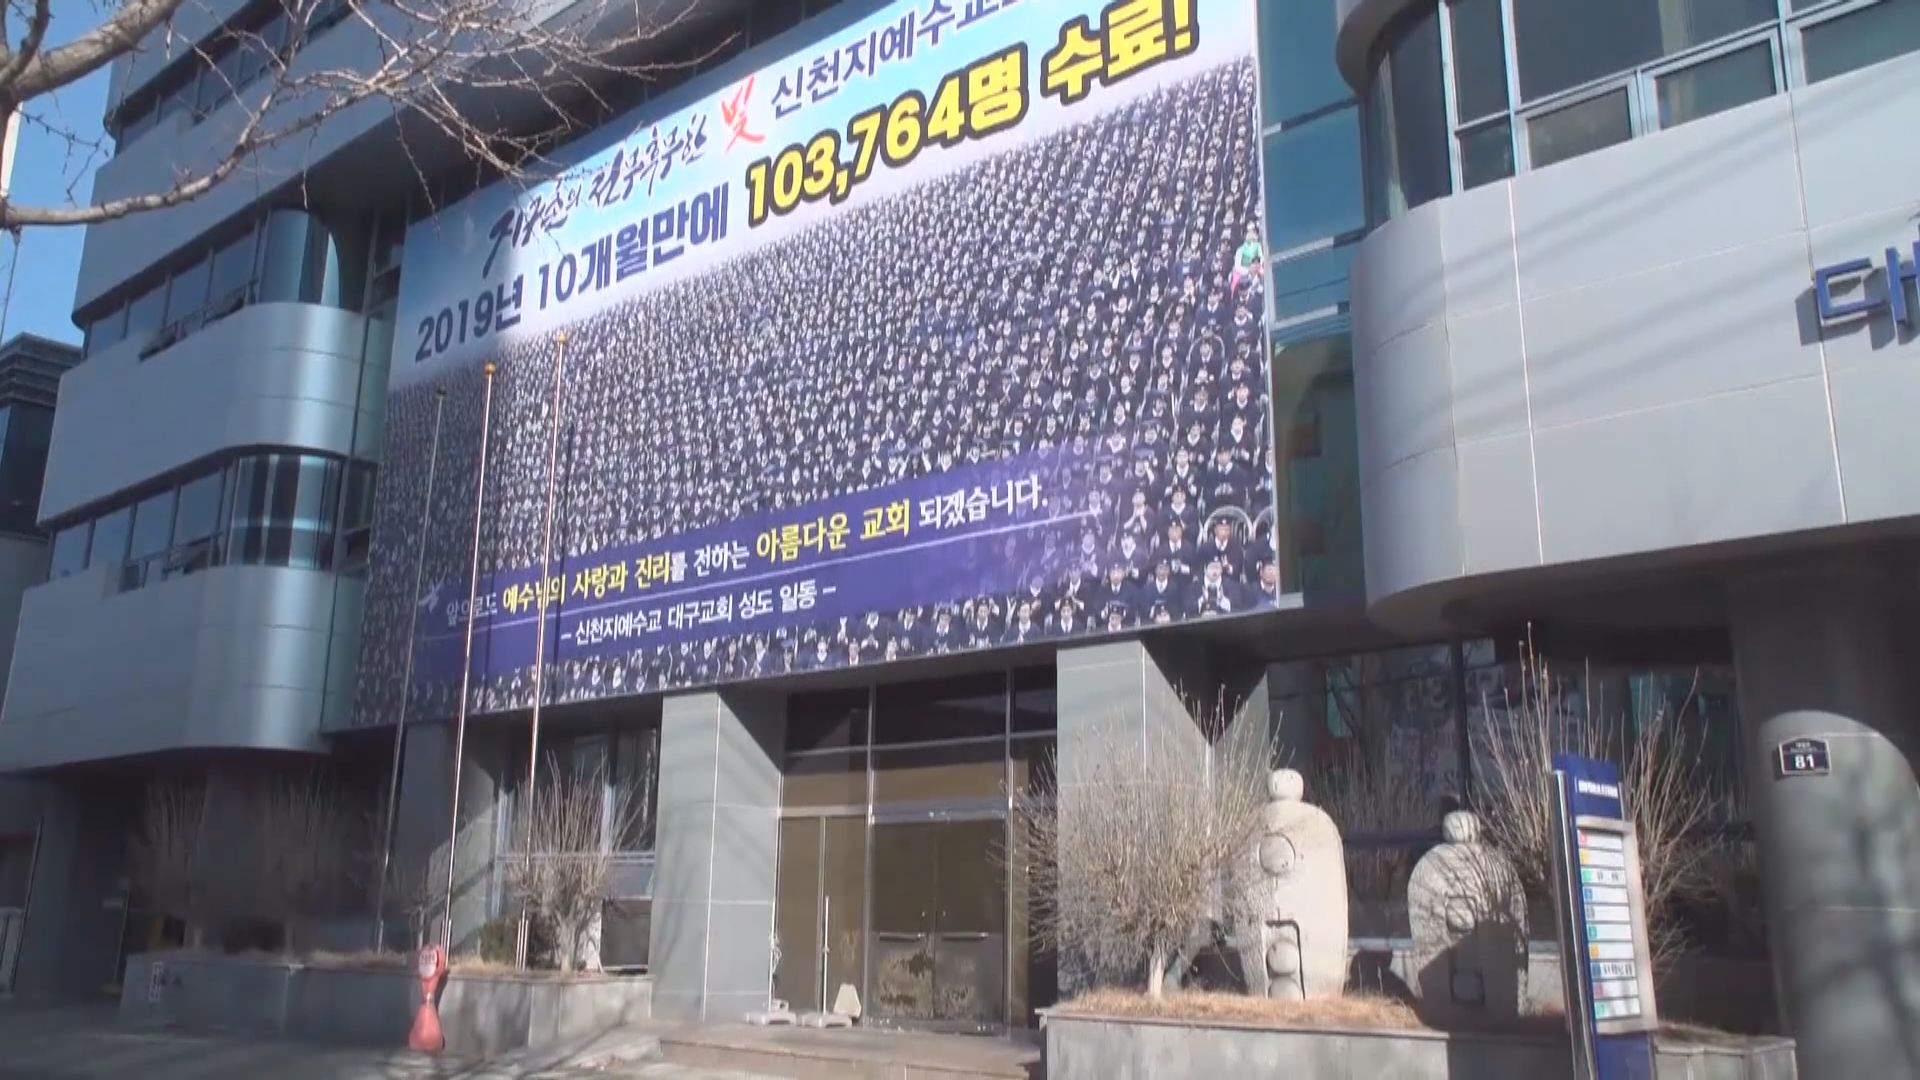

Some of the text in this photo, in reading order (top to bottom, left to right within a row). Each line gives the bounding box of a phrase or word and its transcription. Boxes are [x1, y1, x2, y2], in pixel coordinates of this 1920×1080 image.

[414, 0, 1200, 363] 2019년 10개월만에 103,764명 수료!
[588, 113, 707, 207] 전무후무한
[721, 74, 765, 153] 빛
[502, 574, 566, 614] 예수님의
[572, 561, 628, 598] 사랑과
[635, 550, 687, 589] 진리를
[693, 541, 750, 575] 전하는
[757, 512, 850, 562] 아름다운
[860, 498, 910, 540] 교회
[919, 474, 1048, 529] 되겠습니다.
[575, 609, 661, 646] 신천지예수교
[668, 594, 733, 629] 대구교회
[738, 588, 774, 617] 성도
[779, 579, 817, 613] 일동
[1794, 753, 1815, 769] 81
